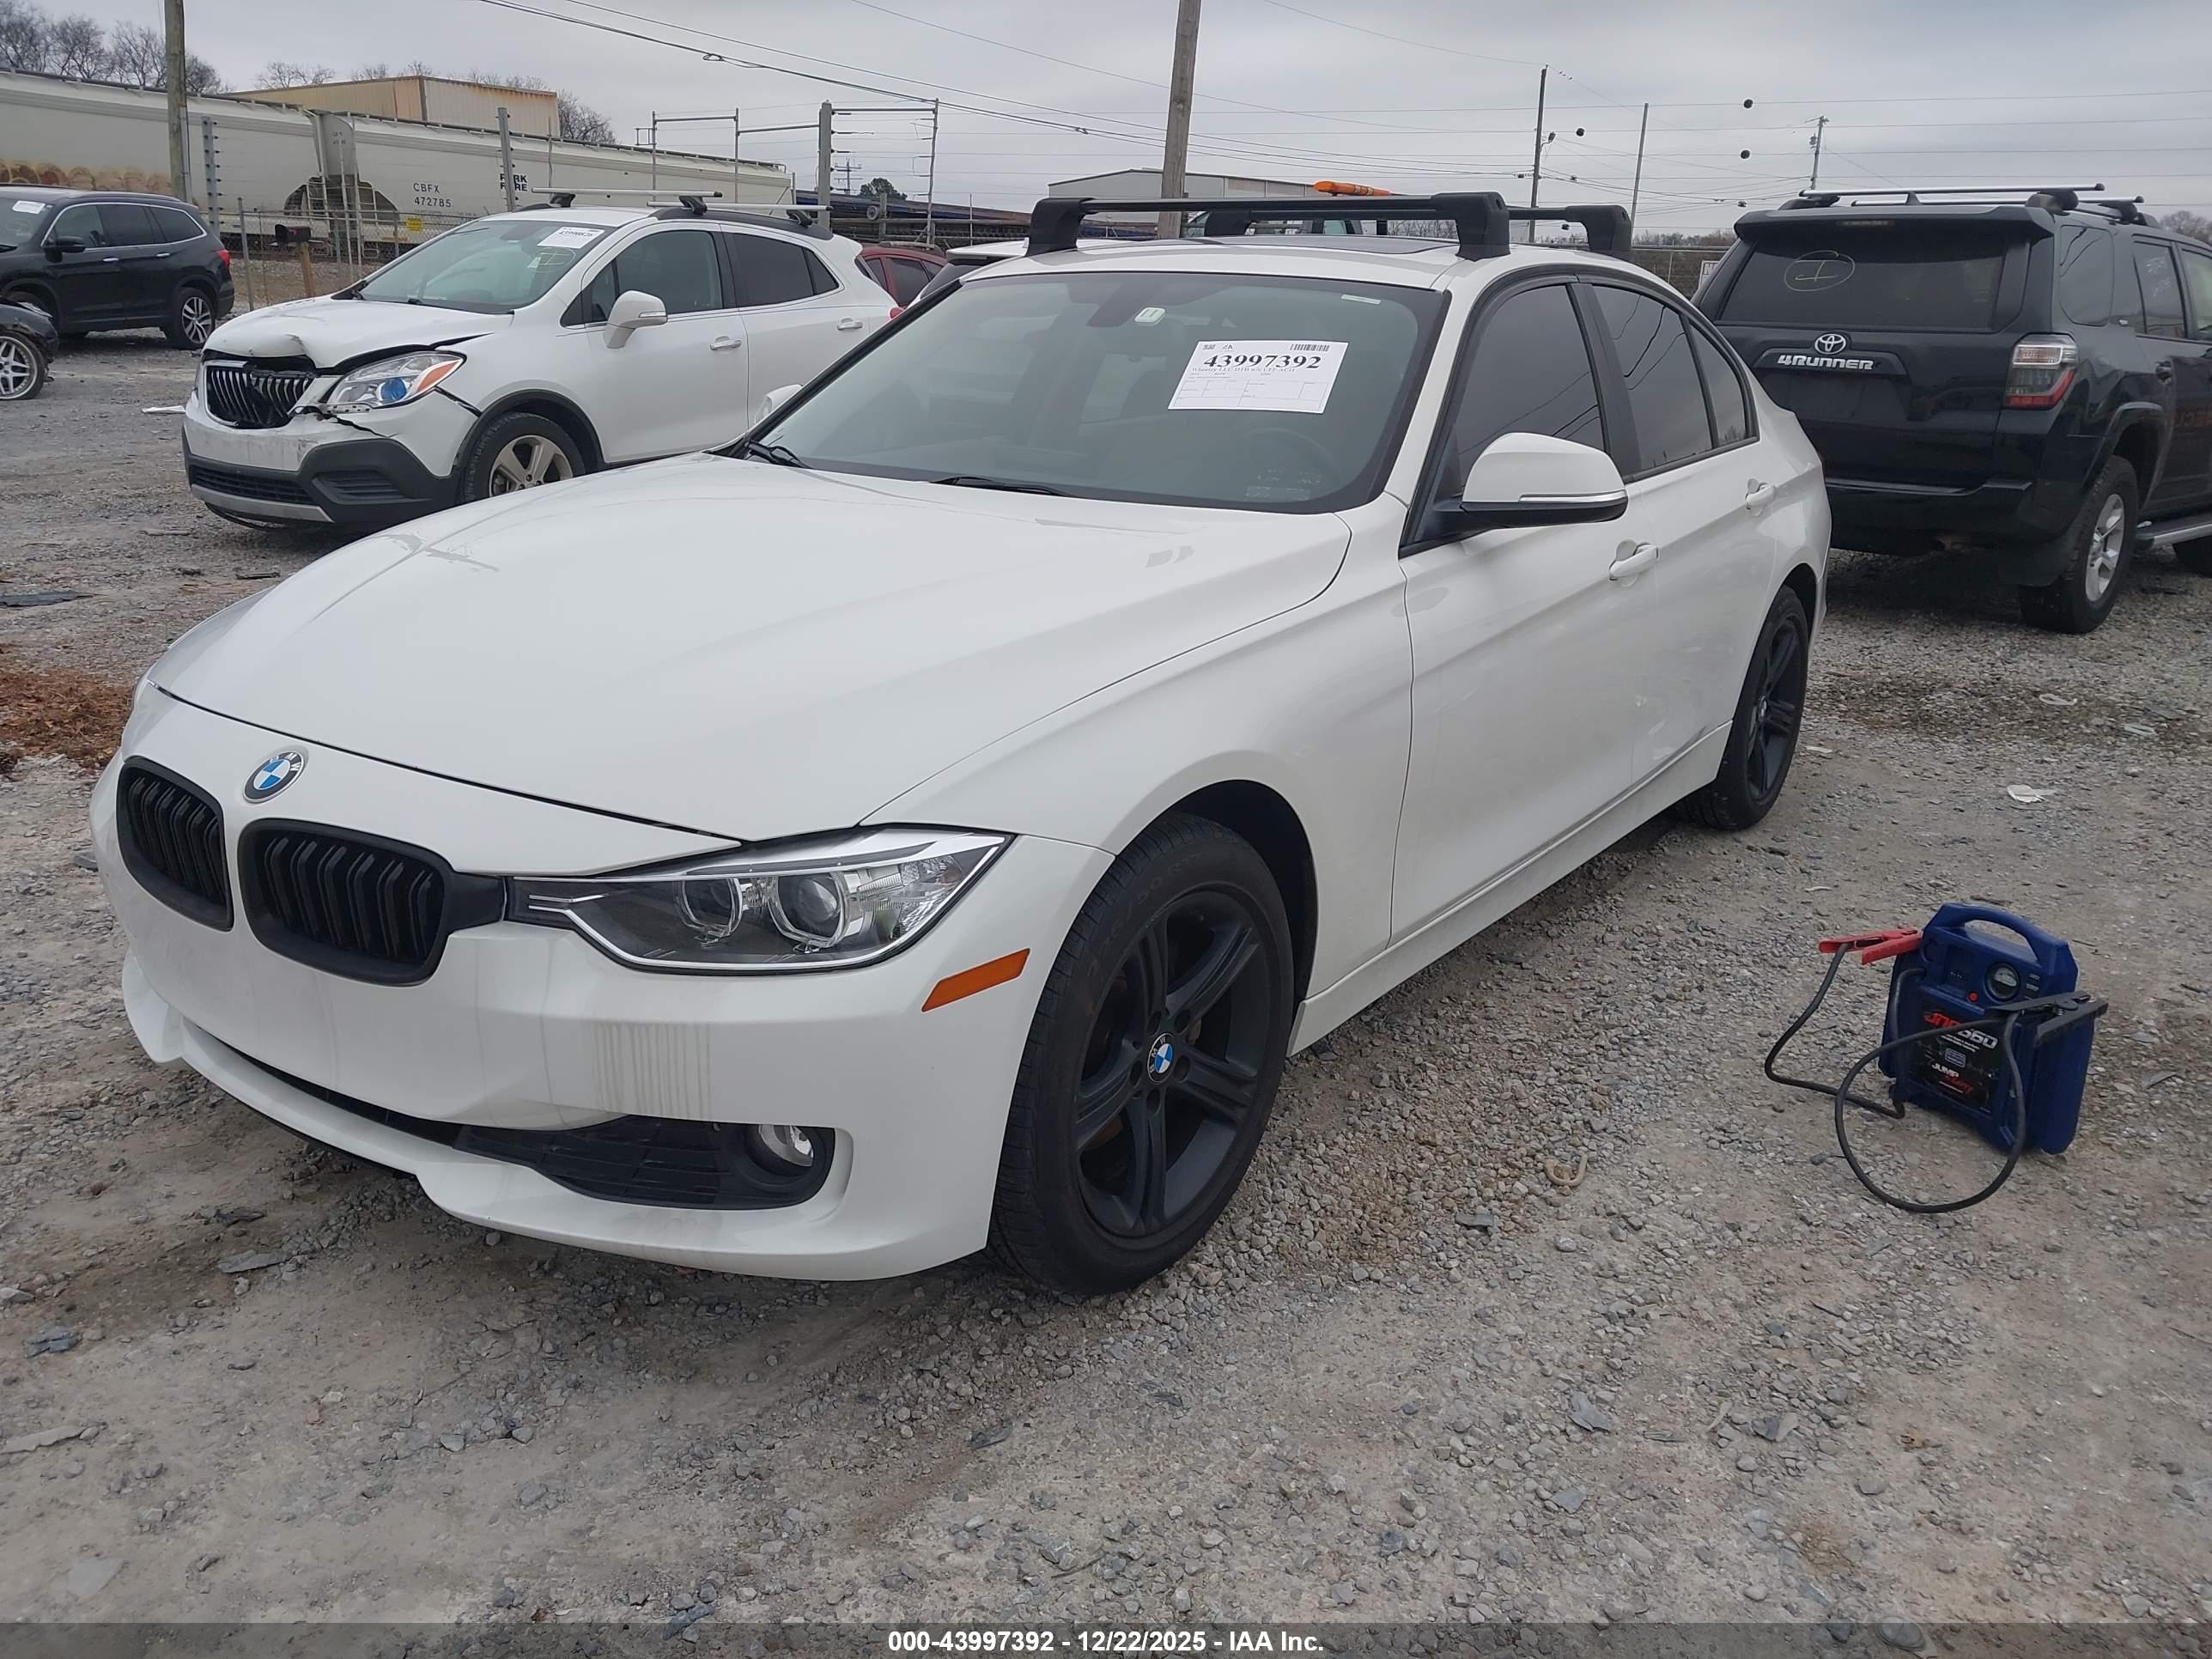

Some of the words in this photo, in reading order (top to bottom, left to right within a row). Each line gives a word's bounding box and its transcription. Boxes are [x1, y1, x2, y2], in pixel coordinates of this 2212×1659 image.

[413, 182, 441, 194] CBFX
[414, 196, 452, 208] 472785
[1203, 354, 1322, 370] 43997392
[1777, 354, 1875, 370] 4RUNNER
[1149, 1036, 1167, 1073] BMW
